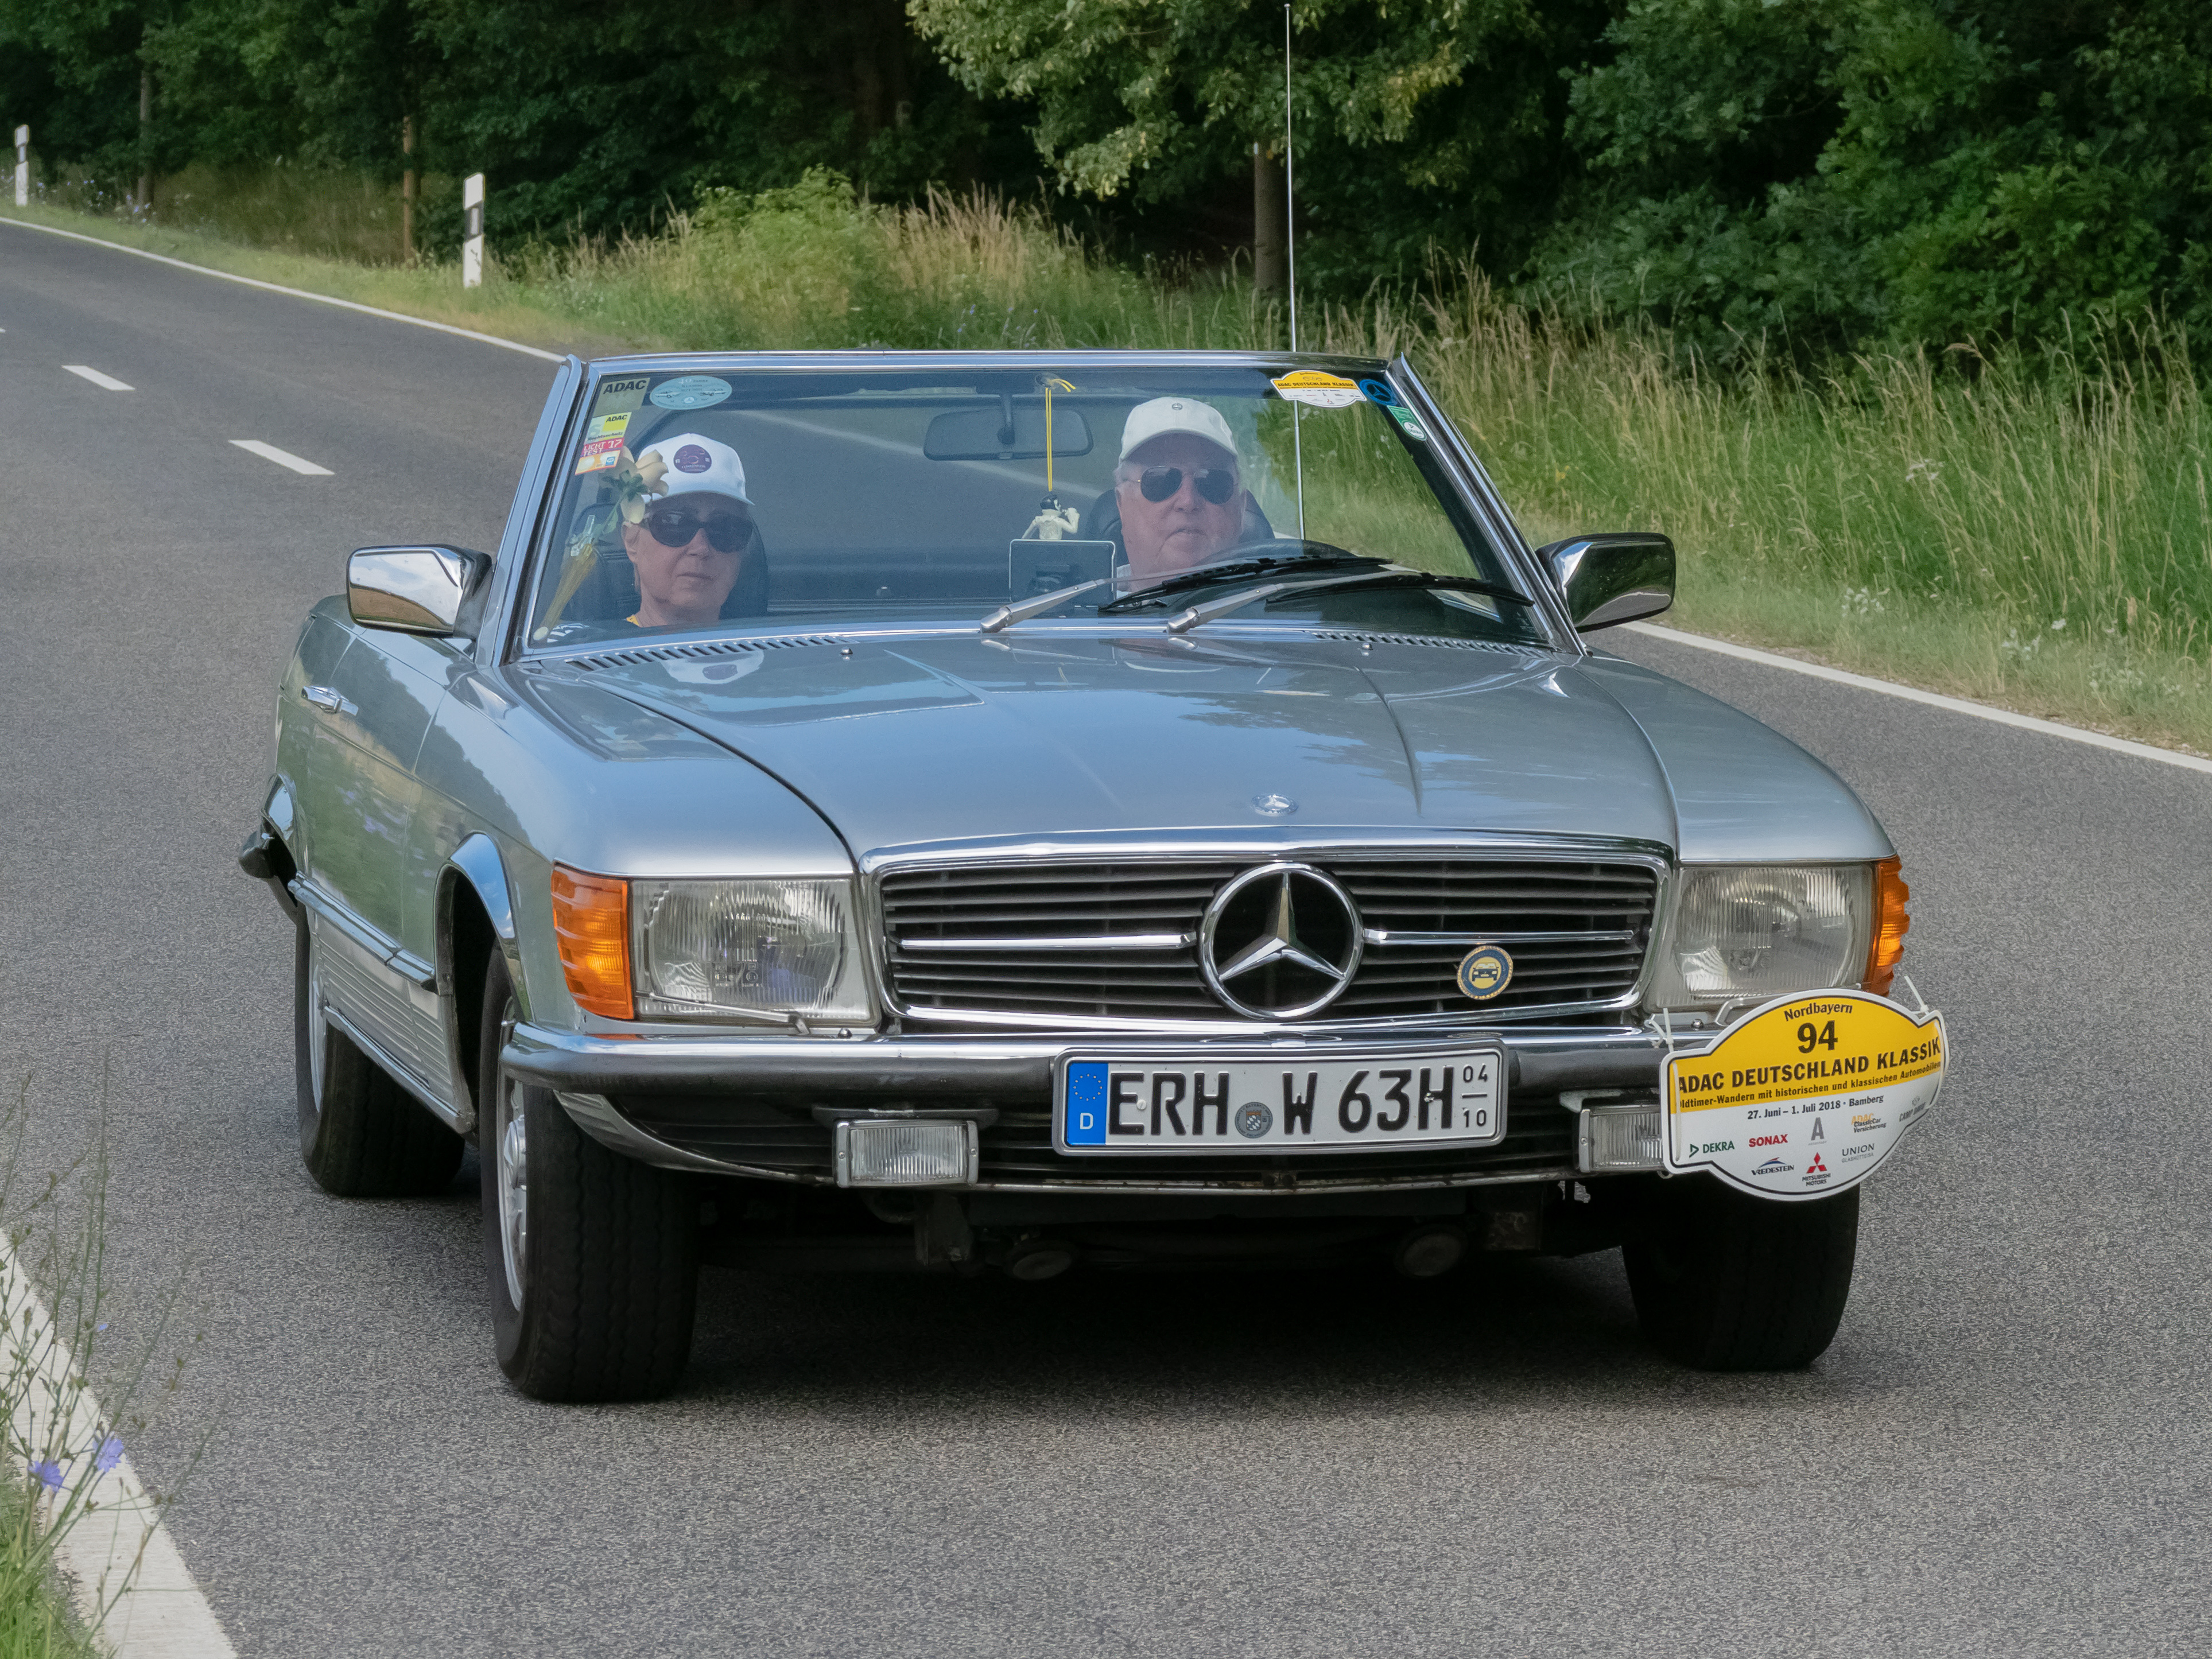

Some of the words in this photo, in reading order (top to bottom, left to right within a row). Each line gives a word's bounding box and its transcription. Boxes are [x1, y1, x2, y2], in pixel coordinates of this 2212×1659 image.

[603, 379, 647, 395] ADAC
[606, 414, 628, 423] ADAC
[583, 441, 606, 451] LICHT
[583, 448, 603, 457] TEST
[1783, 1002, 1853, 1021] Nordbayern
[1797, 1020, 1838, 1054] 94
[1678, 1072, 1724, 1093] ADAC
[1732, 1056, 1869, 1088] DEUTSCHLAND
[1876, 1036, 1941, 1070] KLASSIK
[1462, 1064, 1488, 1083] 04
[1676, 1093, 1755, 1109] ldtimer-Wandern
[1758, 1089, 1772, 1099] mit
[1775, 1083, 1829, 1098] historischen
[1832, 1081, 1848, 1091] und
[1850, 1074, 1898, 1088] klassischen
[1108, 1071, 1229, 1136] ERH
[1282, 1072, 1318, 1135] W
[1338, 1066, 1455, 1134] 63H
[1747, 1110, 1762, 1120] 27.
[1764, 1107, 1781, 1118] Juni
[1791, 1106, 1799, 1114] 1.
[1801, 1103, 1816, 1114] Juli
[1818, 1100, 1841, 1111] 2018
[1849, 1095, 1884, 1107] Bamberg
[1079, 1113, 1095, 1130] D
[1462, 1109, 1487, 1128] 10
[1702, 1140, 1735, 1153] DEKRA
[1748, 1134, 1788, 1148] SONAX
[1842, 1143, 1875, 1156] UNION
[1751, 1164, 1795, 1176] VREDESTEIN
[1802, 1172, 1831, 1182] MITSUBISHI
[1806, 1178, 1827, 1187] MOTORS
